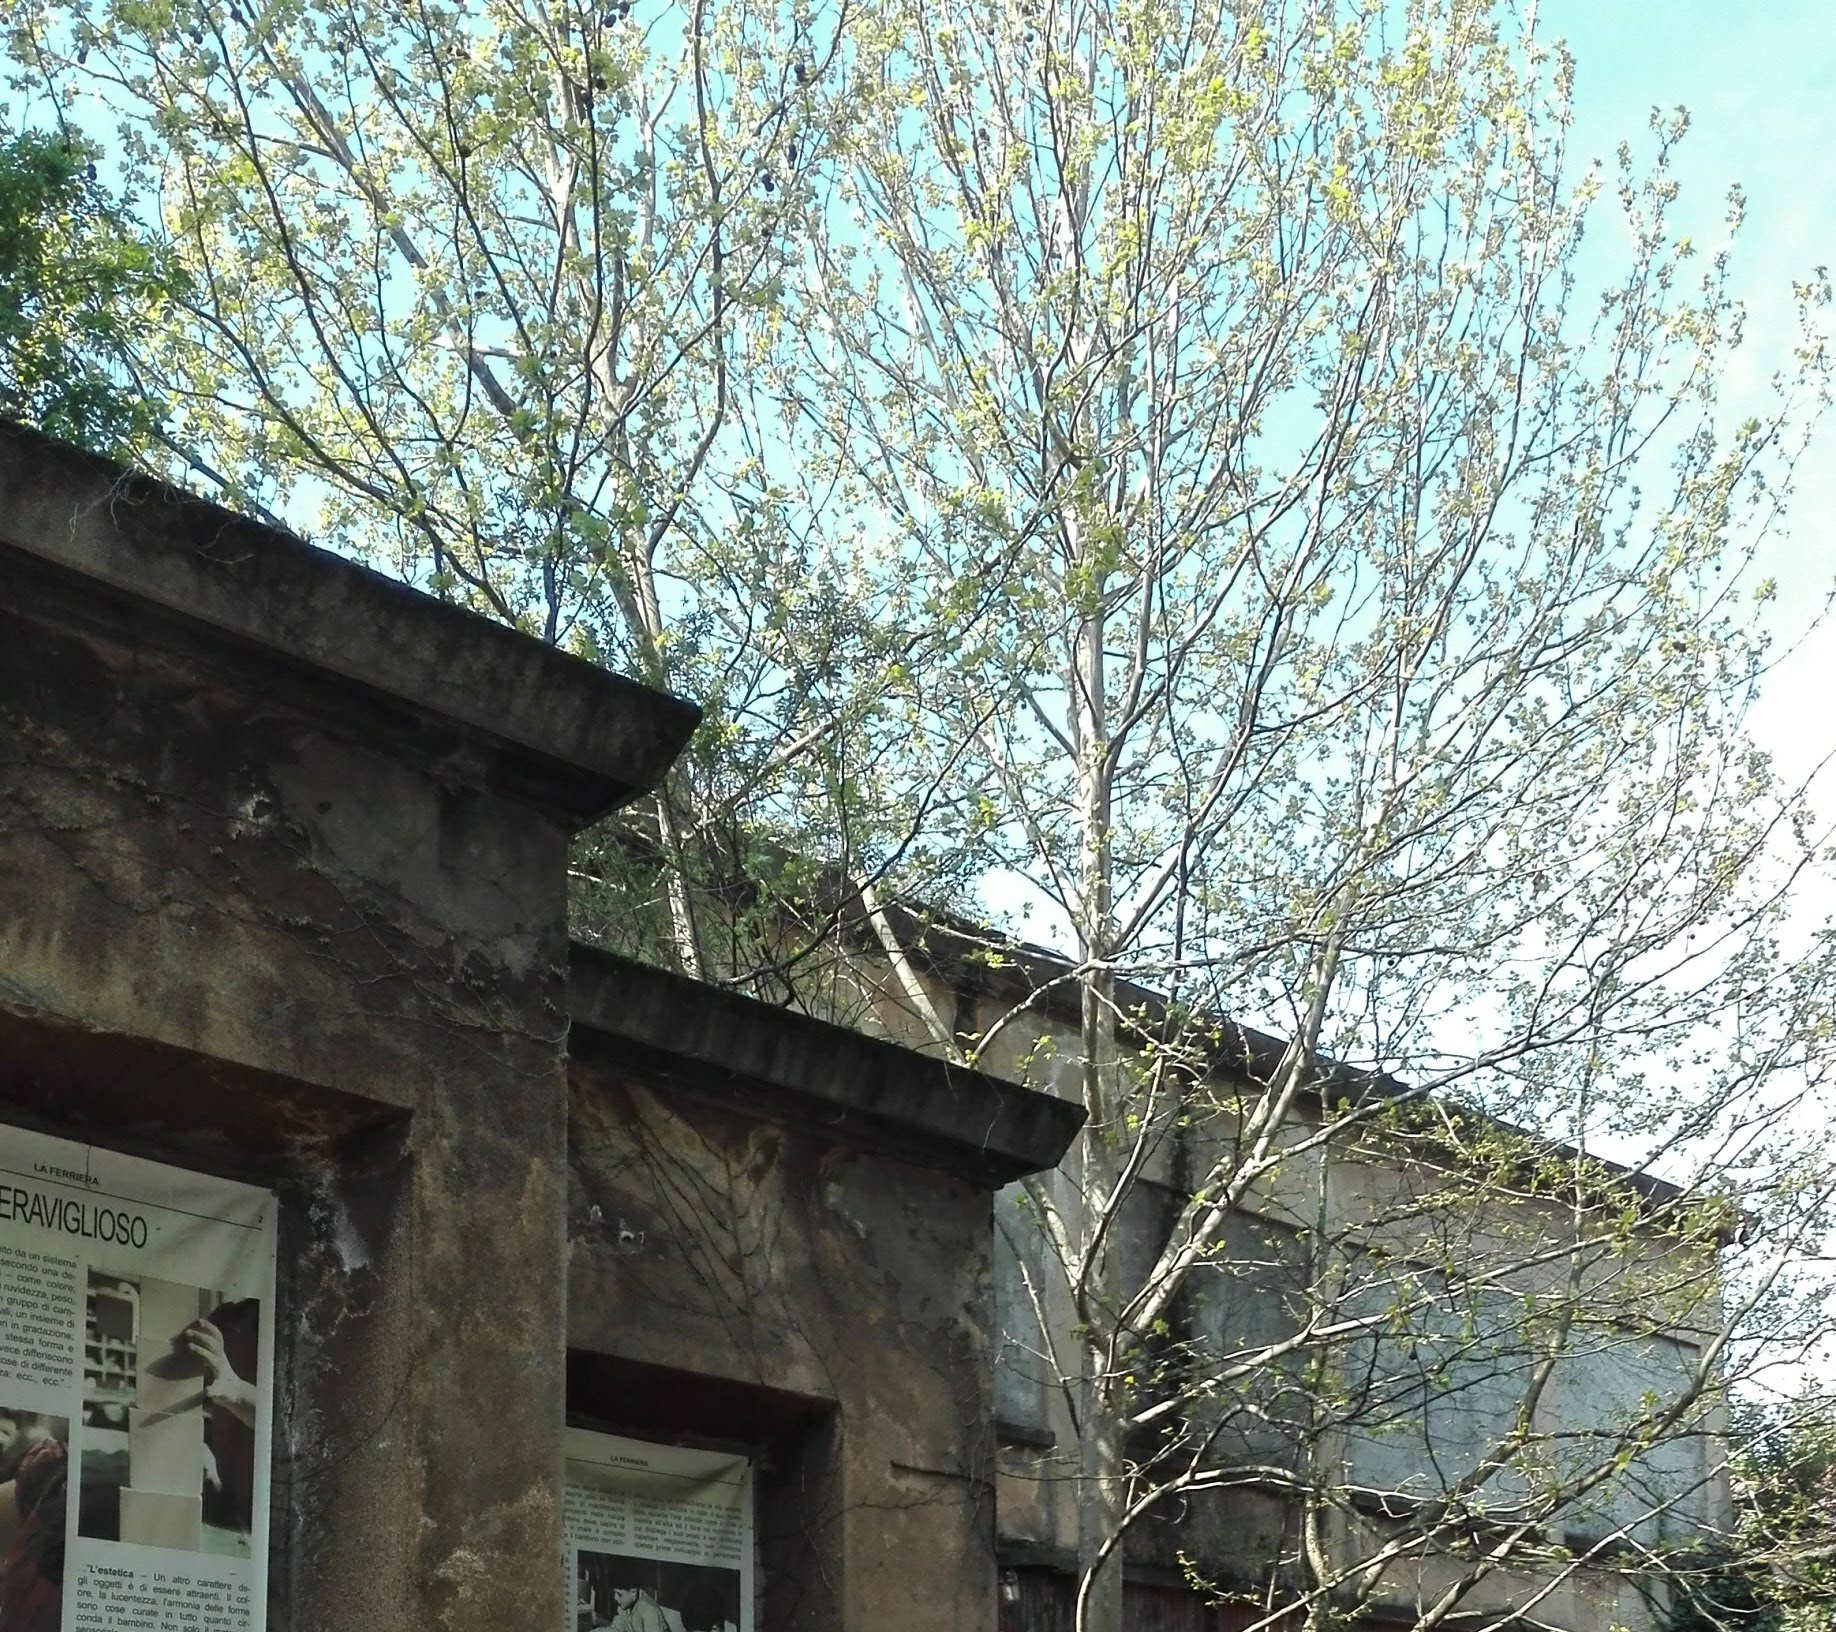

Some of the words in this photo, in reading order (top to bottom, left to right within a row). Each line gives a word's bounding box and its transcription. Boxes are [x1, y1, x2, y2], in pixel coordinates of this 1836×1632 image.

[34, 1163, 48, 1174] LA
[49, 1166, 100, 1185] FERRIERA
[14, 1249, 26, 1258] da
[42, 1256, 77, 1269] sistema
[16, 1274, 41, 1285] come
[41, 1268, 58, 1277] una
[61, 1271, 76, 1280] de-
[6, 1297, 38, 1309] gruppo
[41, 1303, 50, 1311] di
[53, 1306, 75, 1316] cam-
[30, 1312, 64, 1326] insieme
[66, 1320, 74, 1328] di
[5, 1333, 34, 1345] stessa
[38, 1338, 64, 1350] forma
[22, 1348, 74, 1364] differiscono
[20, 1360, 29, 1368] di
[31, 1362, 73, 1376] differente
